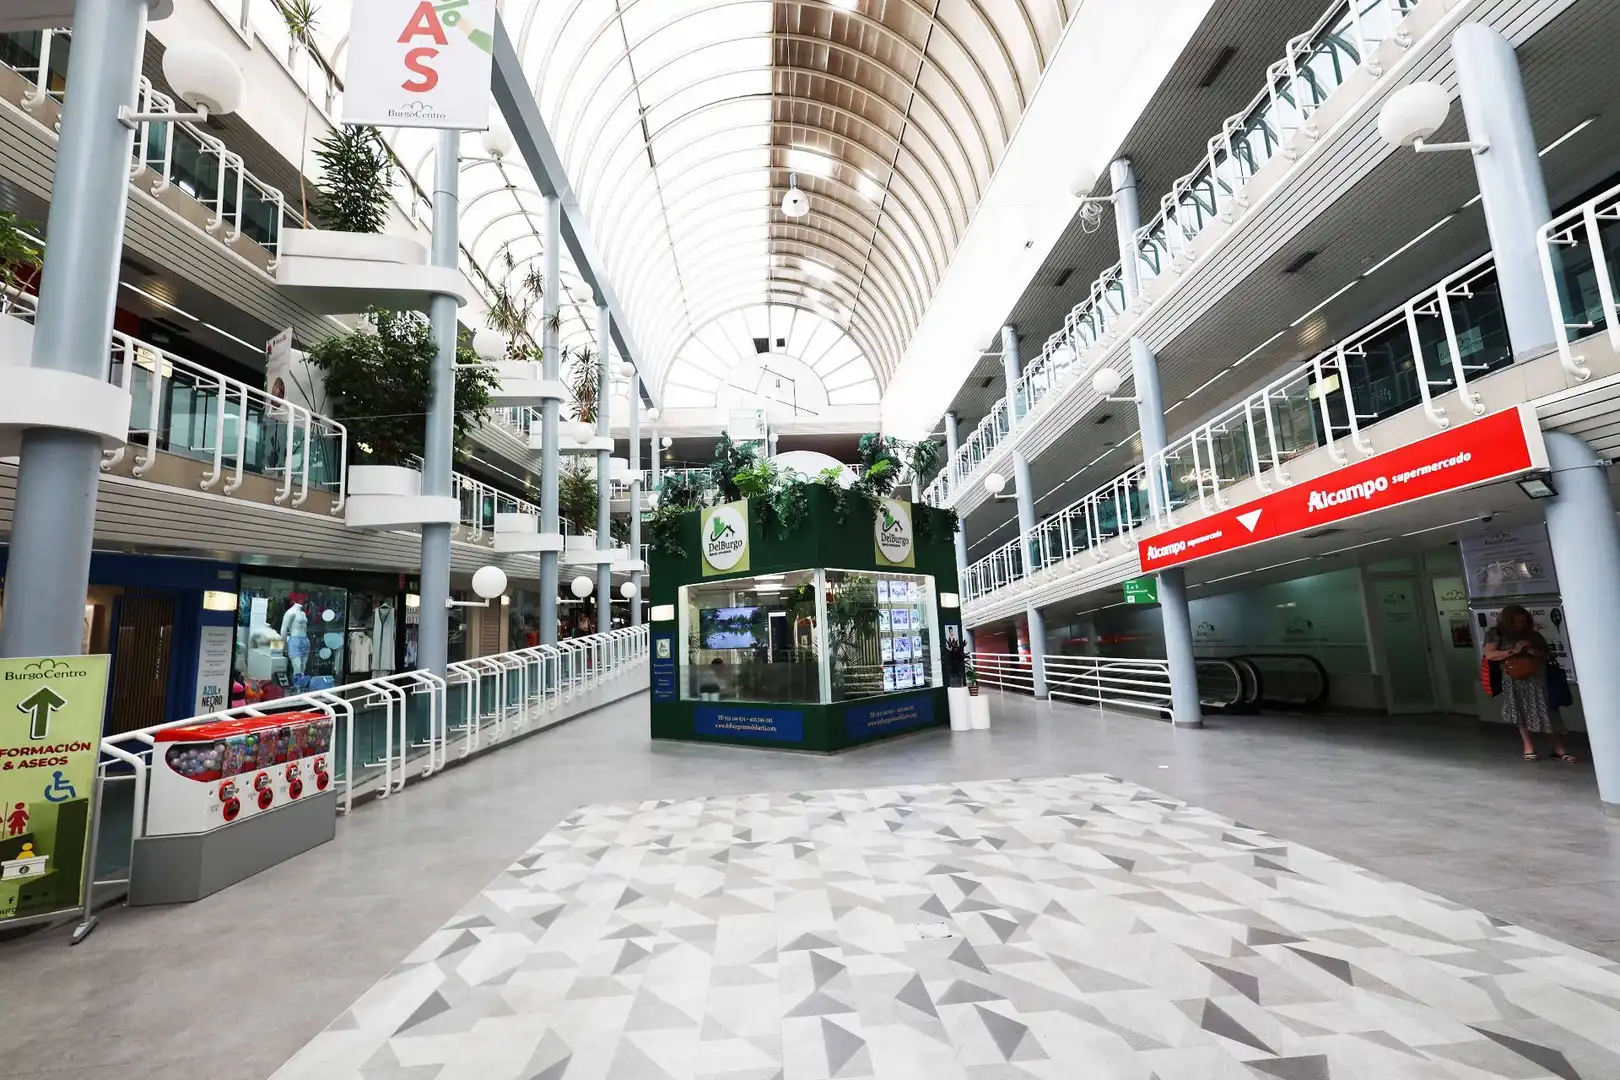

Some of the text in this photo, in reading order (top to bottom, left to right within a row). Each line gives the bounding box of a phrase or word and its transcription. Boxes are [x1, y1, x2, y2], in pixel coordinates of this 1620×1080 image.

[388, 109, 446, 119] BurgoCentro
[1308, 452, 1472, 512] Alcampo supermercado
[709, 540, 743, 552] DelBurgo
[881, 533, 909, 547] DelBurgo
[1147, 530, 1223, 560] Alcampo supermercado
[5, 669, 87, 680] BurgoCentro
[203, 685, 218, 696] AZUL
[201, 695, 223, 711] NEGRO
[3, 756, 68, 770] & ASEOS
